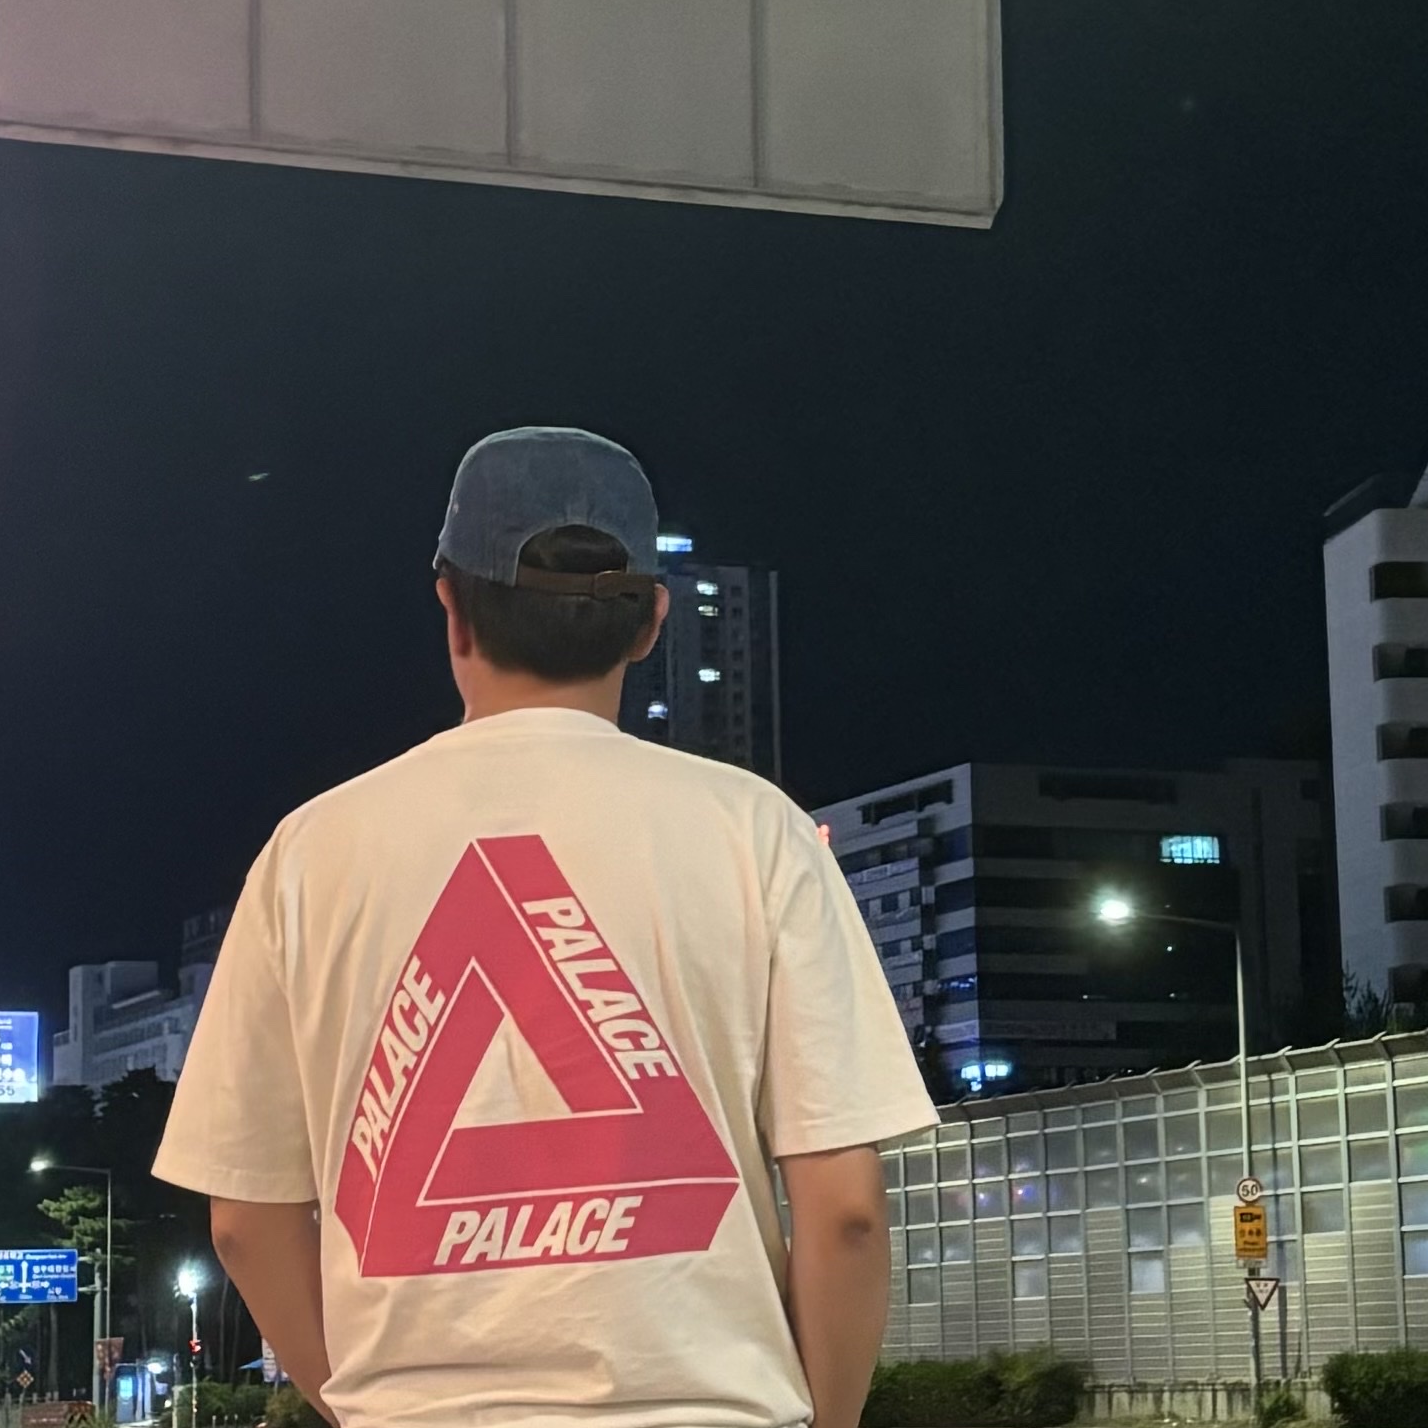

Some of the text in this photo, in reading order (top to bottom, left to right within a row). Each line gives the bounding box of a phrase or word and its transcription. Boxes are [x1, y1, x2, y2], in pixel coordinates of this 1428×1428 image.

[521, 897, 678, 1081] PALACE
[351, 955, 446, 1179] PALACE
[434, 1194, 643, 1266] PALACE
[1241, 1184, 1259, 1198] 50
